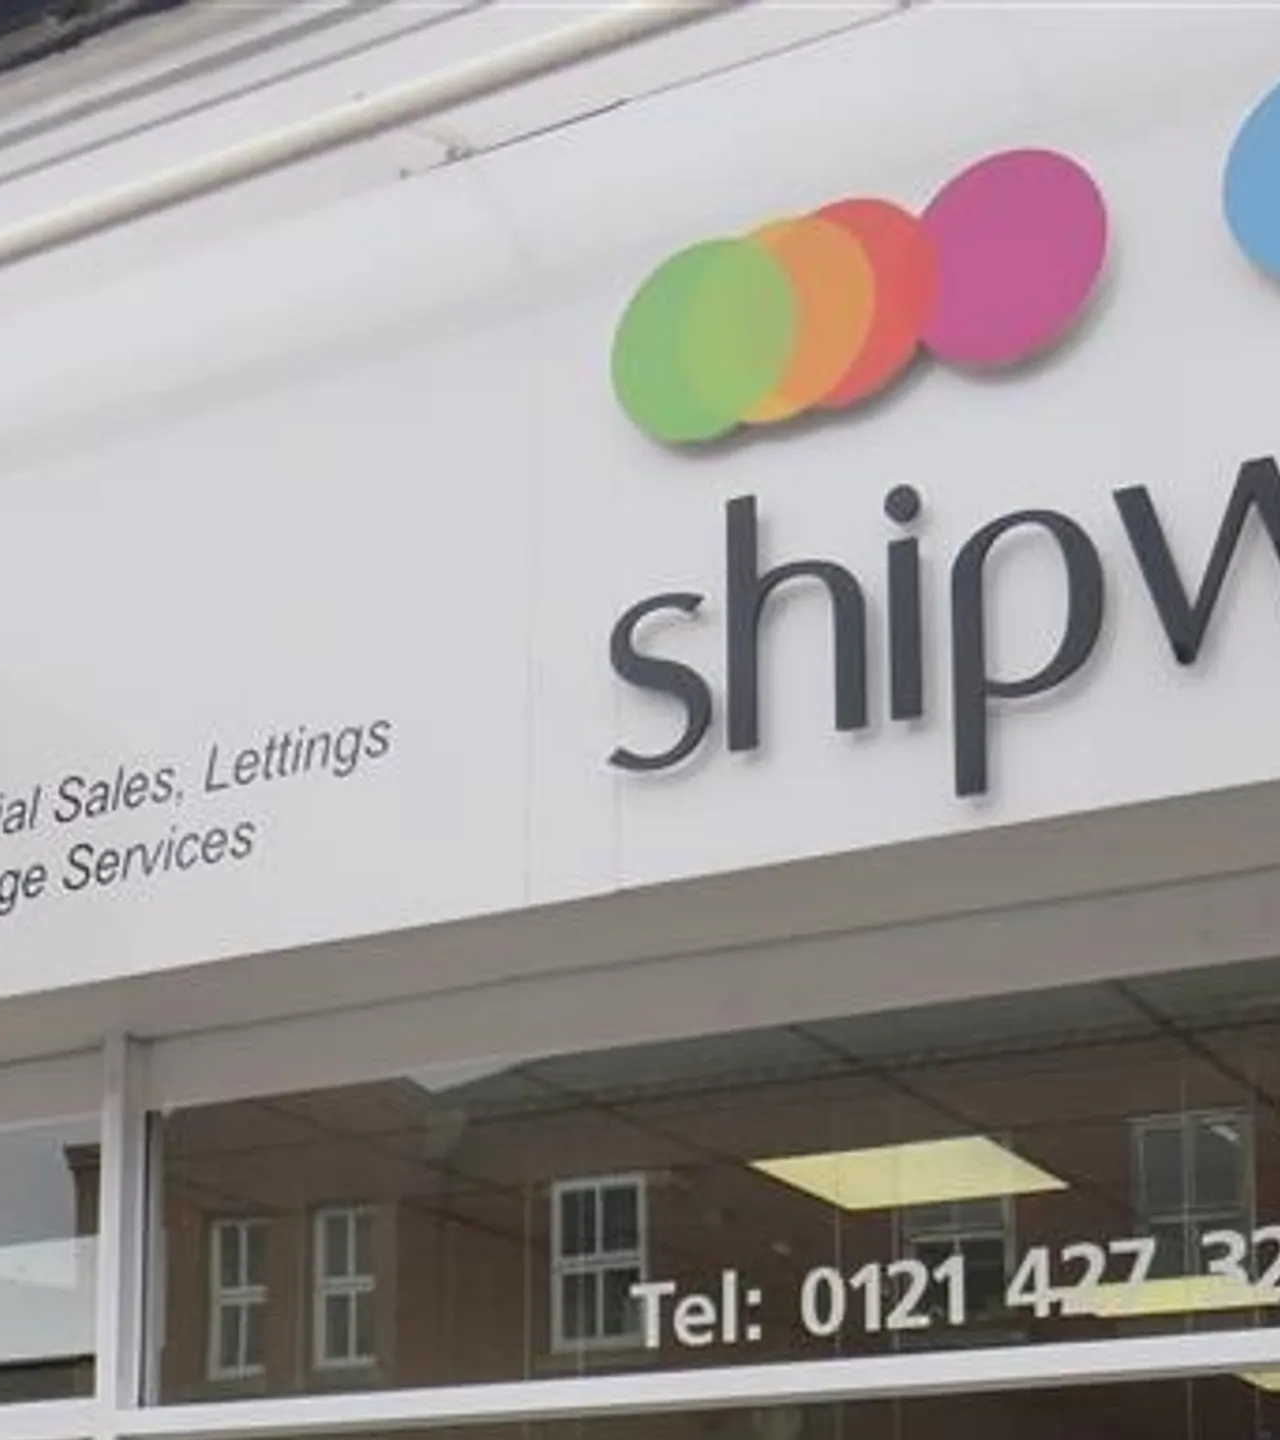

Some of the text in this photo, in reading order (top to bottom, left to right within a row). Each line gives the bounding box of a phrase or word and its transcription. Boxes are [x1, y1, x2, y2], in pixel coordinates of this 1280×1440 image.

[203, 717, 392, 796] Lettings
[63, 817, 255, 891] Services
[630, 1270, 762, 1349] Tel:
[800, 1255, 967, 1336] 0121
[1005, 1240, 1156, 1317] 427
